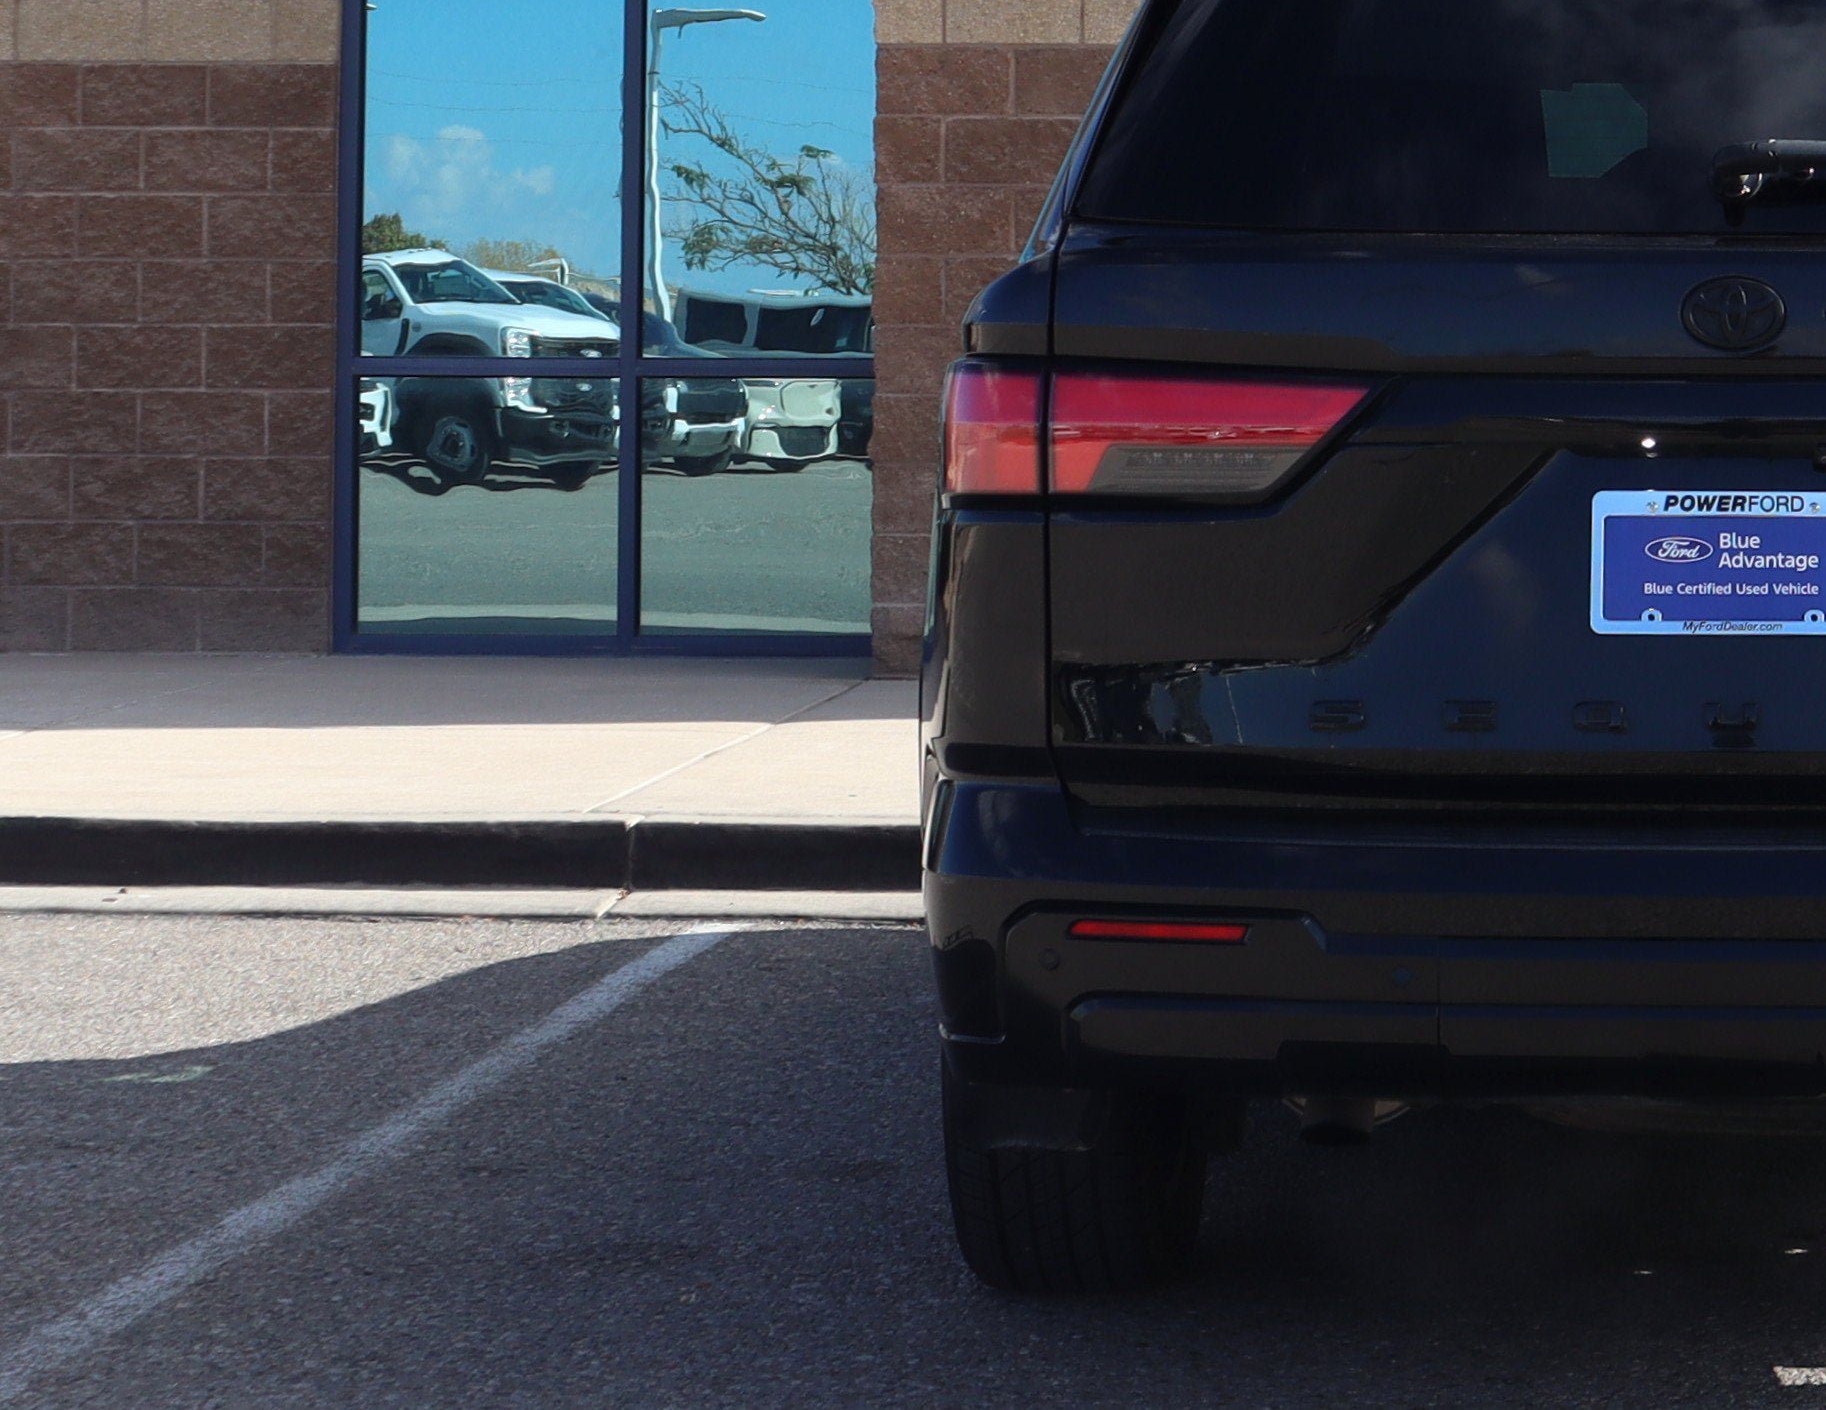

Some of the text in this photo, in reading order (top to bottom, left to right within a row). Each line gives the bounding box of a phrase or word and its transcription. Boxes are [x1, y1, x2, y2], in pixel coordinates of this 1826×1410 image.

[1719, 532, 1761, 549] Blue
[1657, 540, 1700, 559] Ford
[1718, 552, 1819, 571] Advantage
[1644, 582, 1819, 595] Blue Certified Used Vehicle
[1682, 620, 1783, 634] MyFordDealer.com
